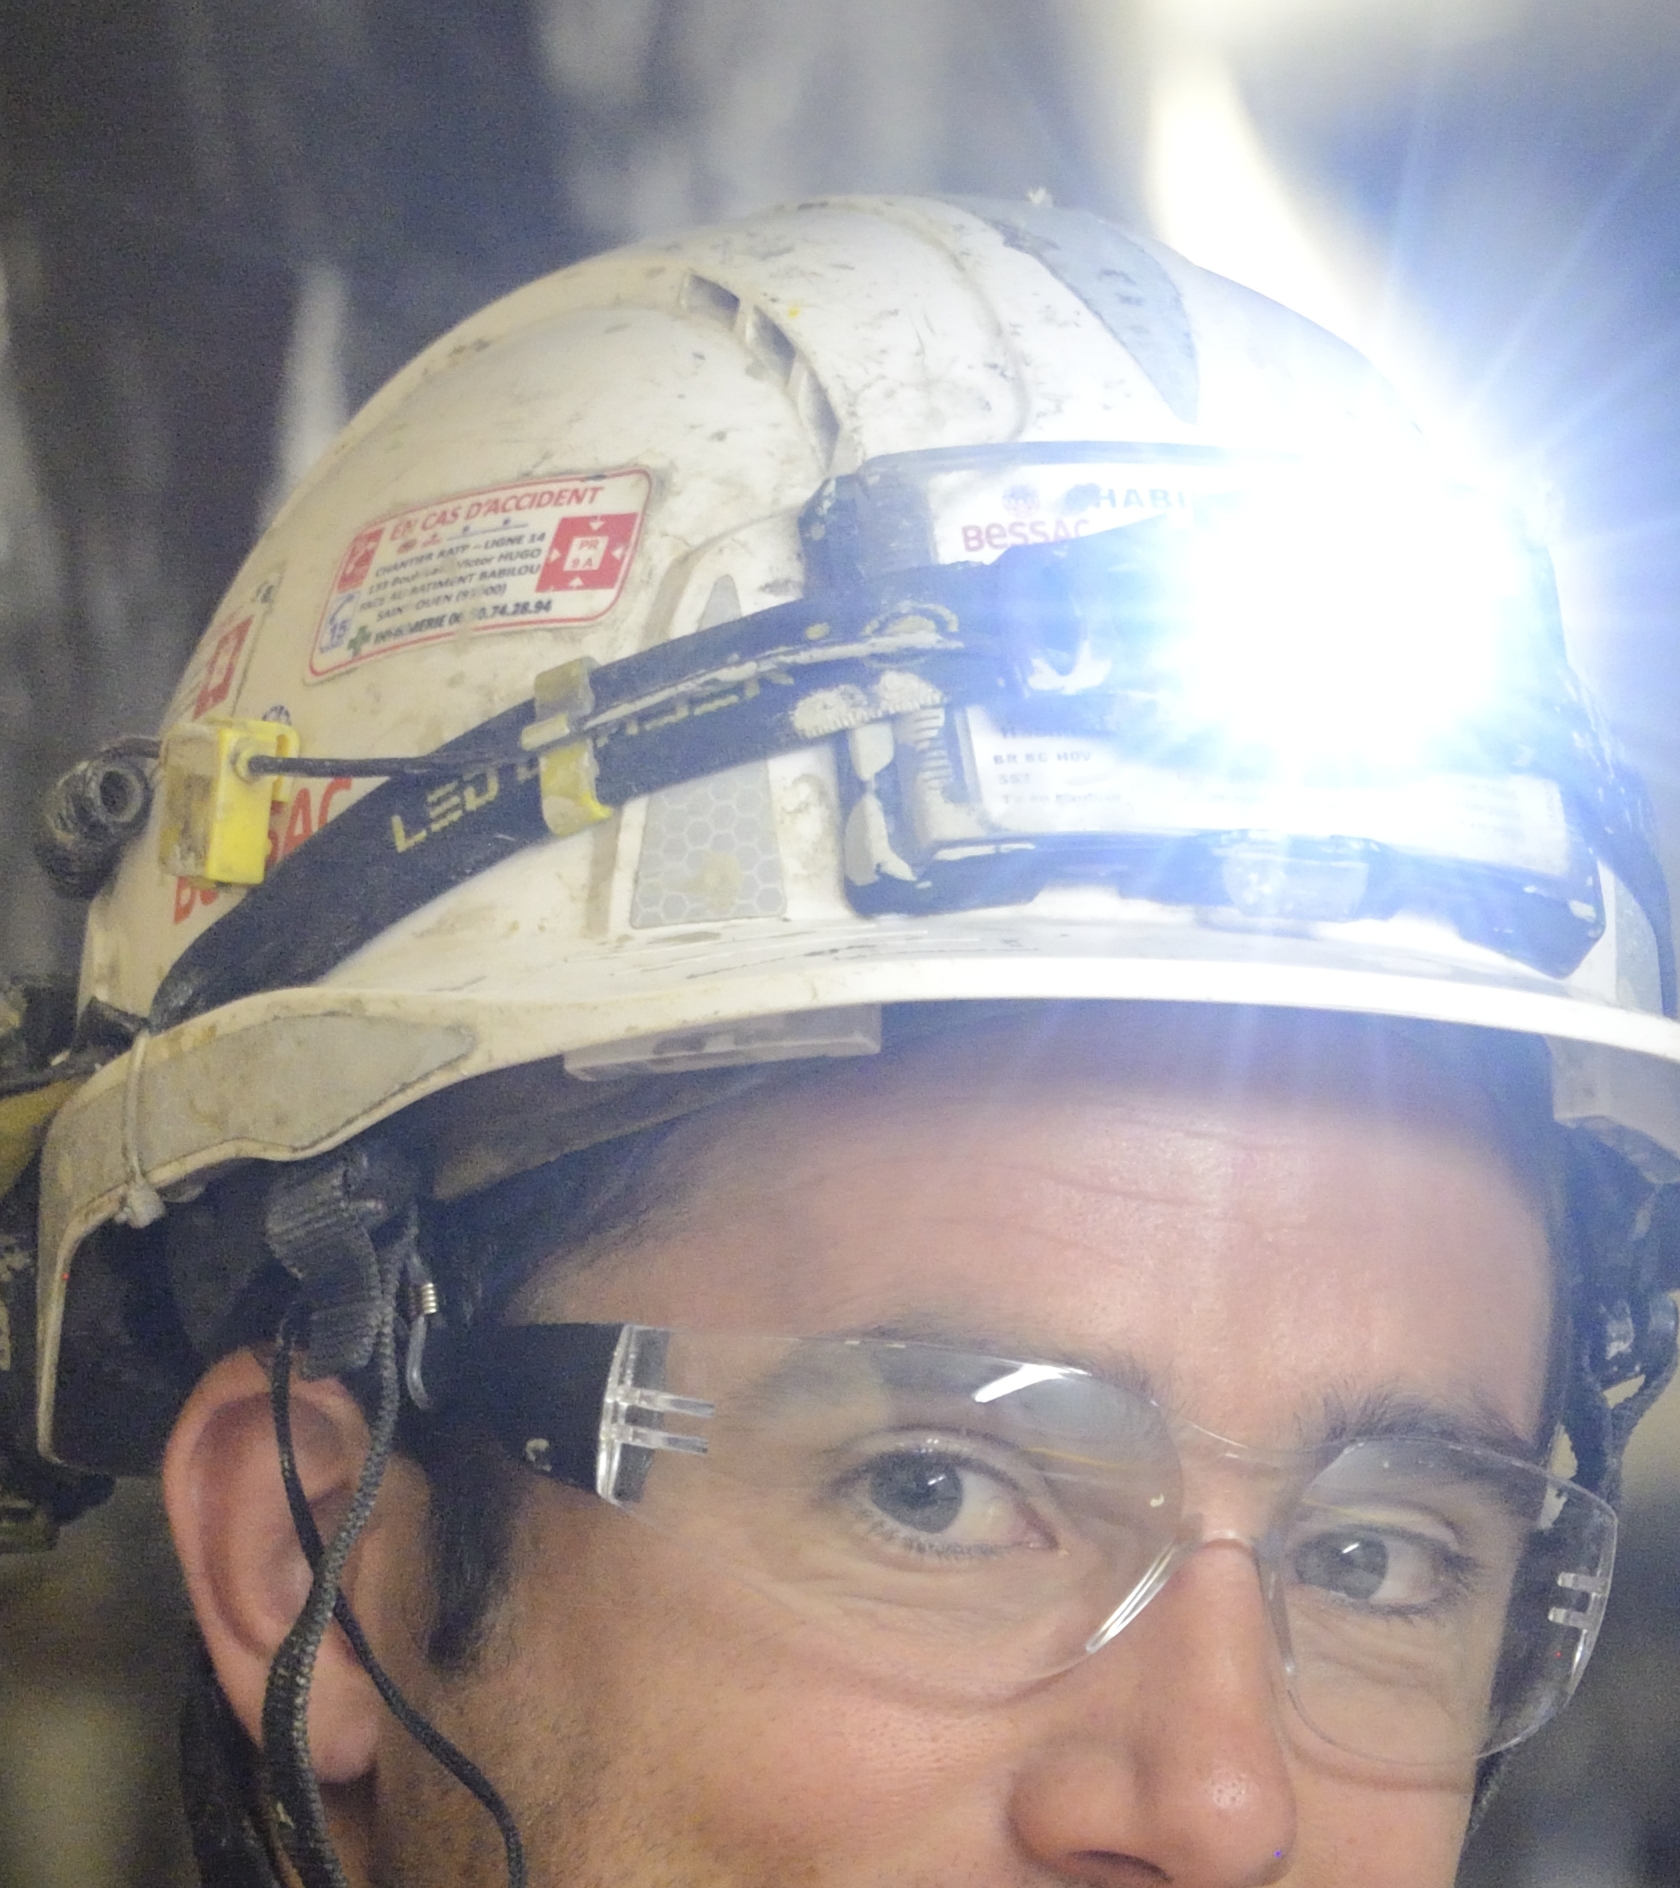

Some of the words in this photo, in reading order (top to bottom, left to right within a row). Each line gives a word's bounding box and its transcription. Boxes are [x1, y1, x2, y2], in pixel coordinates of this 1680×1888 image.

[421, 506, 462, 531] CAS
[464, 486, 605, 521] D'ACCIDENT
[374, 552, 435, 578] CHANTIER
[437, 543, 471, 560] RATP
[483, 534, 526, 550] LIGNE
[528, 532, 547, 544] 14
[497, 548, 543, 563] HUGO
[478, 564, 543, 581] BABILOU
[377, 606, 407, 622] SAIN
